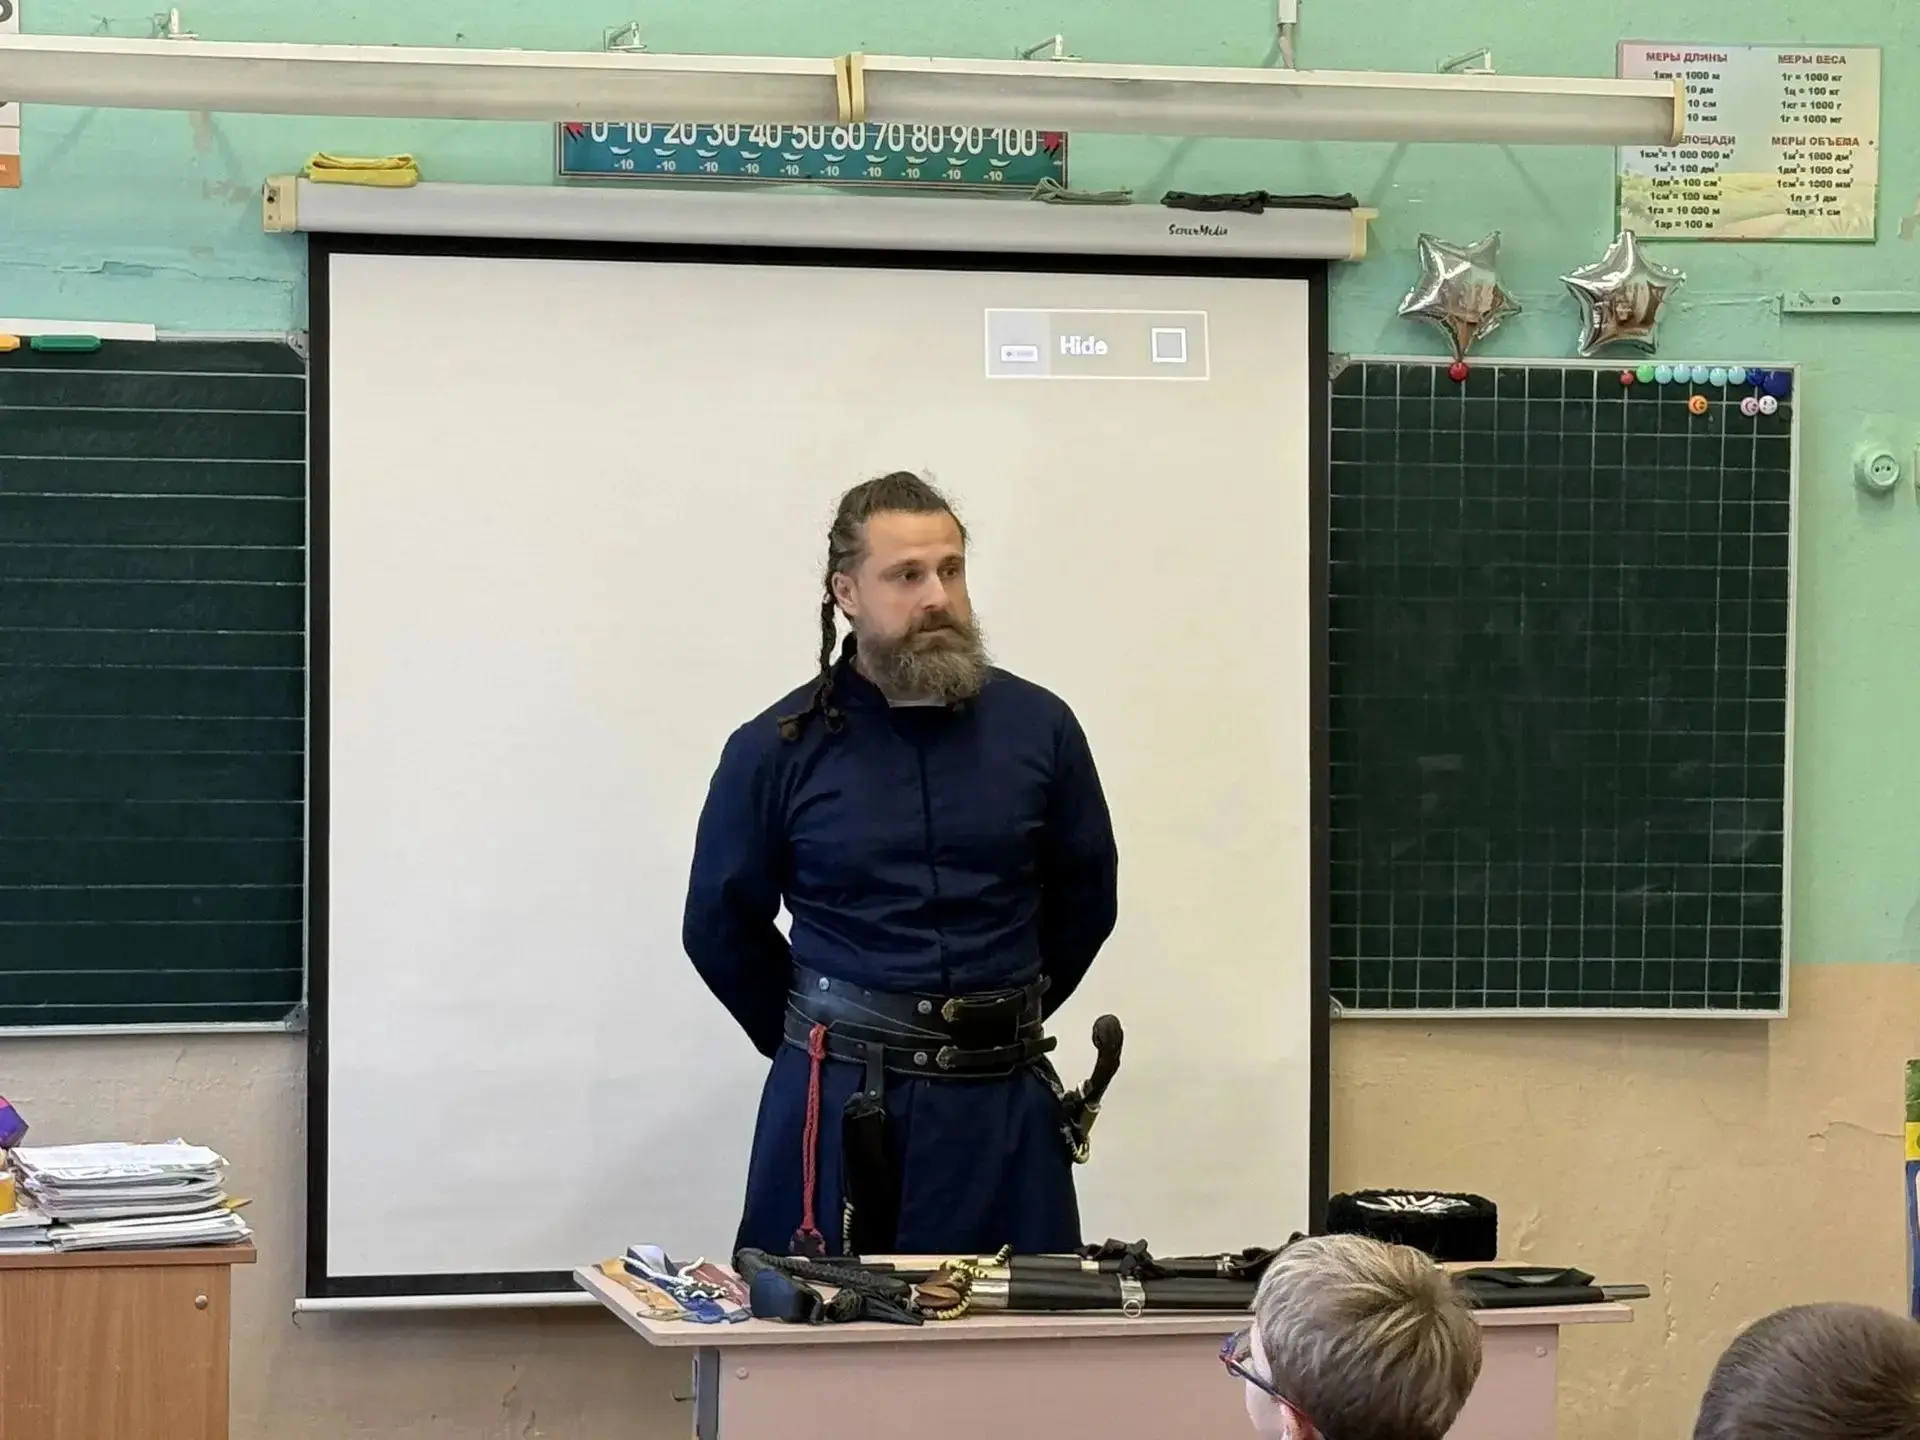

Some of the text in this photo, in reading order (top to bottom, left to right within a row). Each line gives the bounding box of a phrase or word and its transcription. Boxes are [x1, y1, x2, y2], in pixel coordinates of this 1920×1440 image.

[1646, 52, 1727, 63] МЕРЫ ДЛИНЫ
[1778, 55, 1846, 64] МЕРЫ ВЕСА
[1688, 99, 1699, 108] 10
[1810, 101, 1834, 109] 1000
[1803, 115, 1827, 123] 1000
[590, 123, 1036, 156] 0 10 20 30 40 50 60 70 80 90 100
[1772, 136, 1860, 146] МЕРЫ ОБЪЕМА
[1808, 152, 1832, 160] 1000
[614, 160, 1003, 182] -10 -10 -10 -10 -10 -10 -10 -10 -10 -10
[1685, 220, 1702, 228] 100
[1060, 335, 1108, 356] Hide
